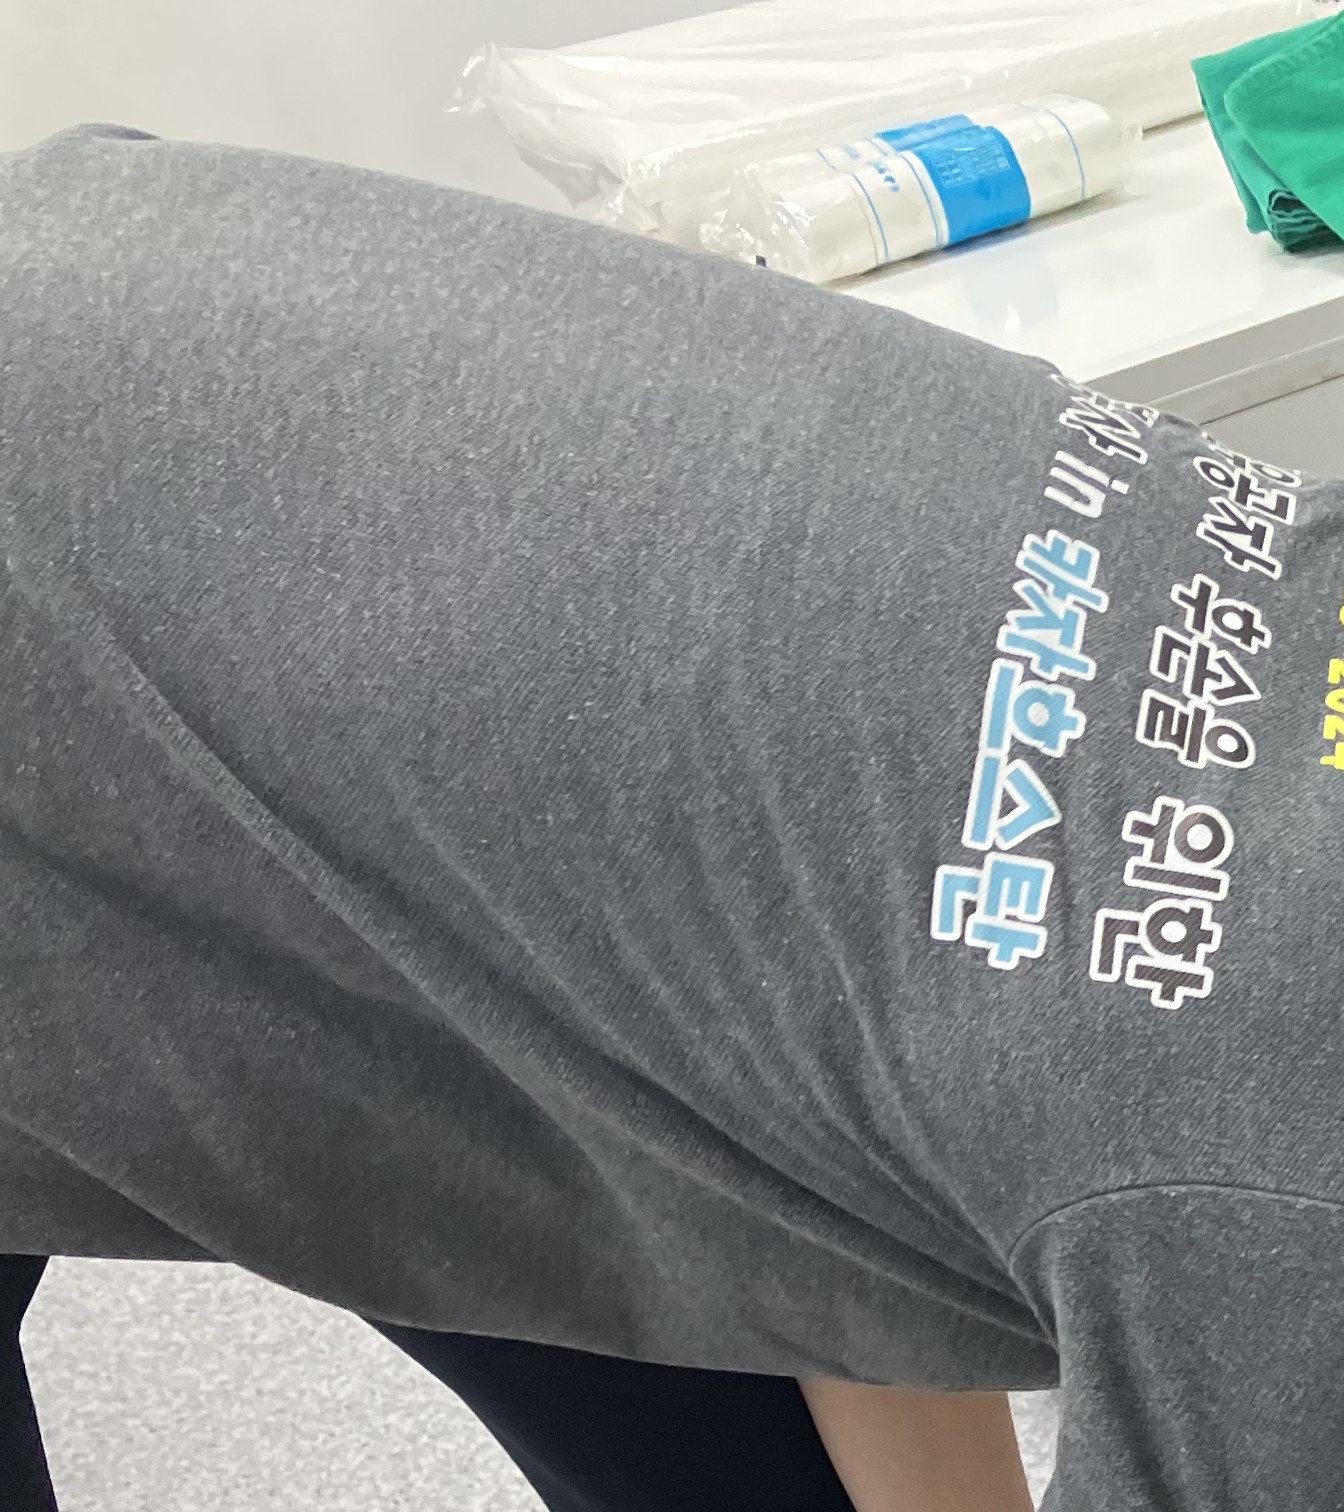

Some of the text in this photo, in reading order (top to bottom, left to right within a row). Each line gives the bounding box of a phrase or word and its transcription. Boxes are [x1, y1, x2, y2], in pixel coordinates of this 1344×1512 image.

[1044, 450, 1130, 518] in
[931, 530, 1109, 970] 카자흐스탄
[1137, 574, 1271, 769] 후손을
[1090, 795, 1235, 1010] 위한
